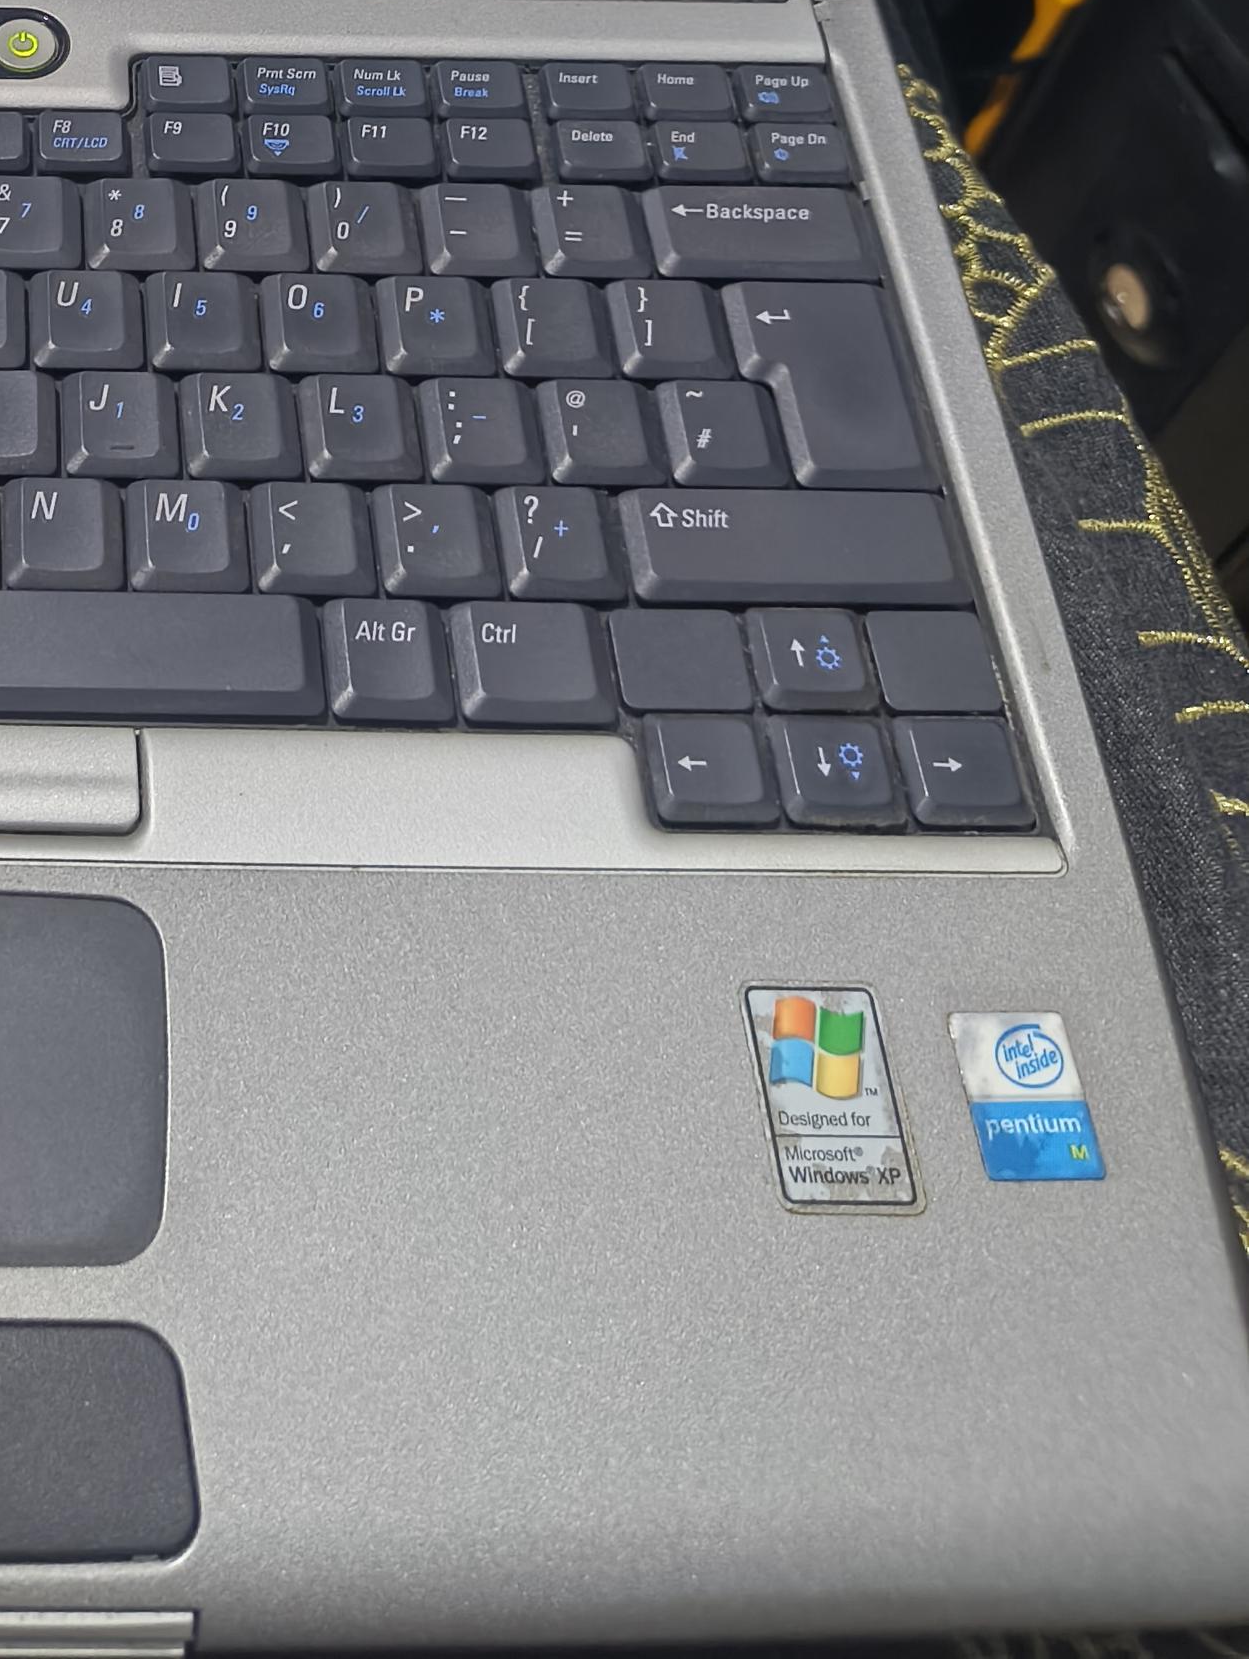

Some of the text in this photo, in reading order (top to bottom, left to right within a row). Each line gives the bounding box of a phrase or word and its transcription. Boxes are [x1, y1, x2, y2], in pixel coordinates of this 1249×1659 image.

[257, 68, 316, 78] Prnt Scrn
[354, 69, 400, 80] Num Lk
[451, 71, 489, 81] Pause
[559, 73, 598, 83] Insert
[658, 74, 694, 85] Home
[756, 75, 808, 88] Page Up
[260, 84, 295, 95] SysRq
[357, 86, 405, 96] Scroll Lk
[454, 87, 488, 97] Break
[53, 120, 71, 133] F8
[164, 121, 182, 134] F9
[263, 123, 289, 136] F10
[362, 125, 386, 138] F11
[461, 126, 487, 139] F12
[572, 130, 613, 141] Delete
[671, 131, 694, 142] End
[772, 133, 826, 146] Page Dn
[54, 138, 107, 148] CRT/LCD
[707, 204, 809, 222] Backspace
[682, 509, 728, 528] Shift
[356, 621, 416, 641] Alt Gr
[482, 623, 516, 643] Ctrl
[1003, 1034, 1034, 1064] intel
[1016, 1050, 1058, 1079] inside
[778, 1110, 870, 1129] Designed for
[986, 1114, 1082, 1140] pentium
[1070, 1145, 1088, 1159] M
[878, 1167, 901, 1187] XP
